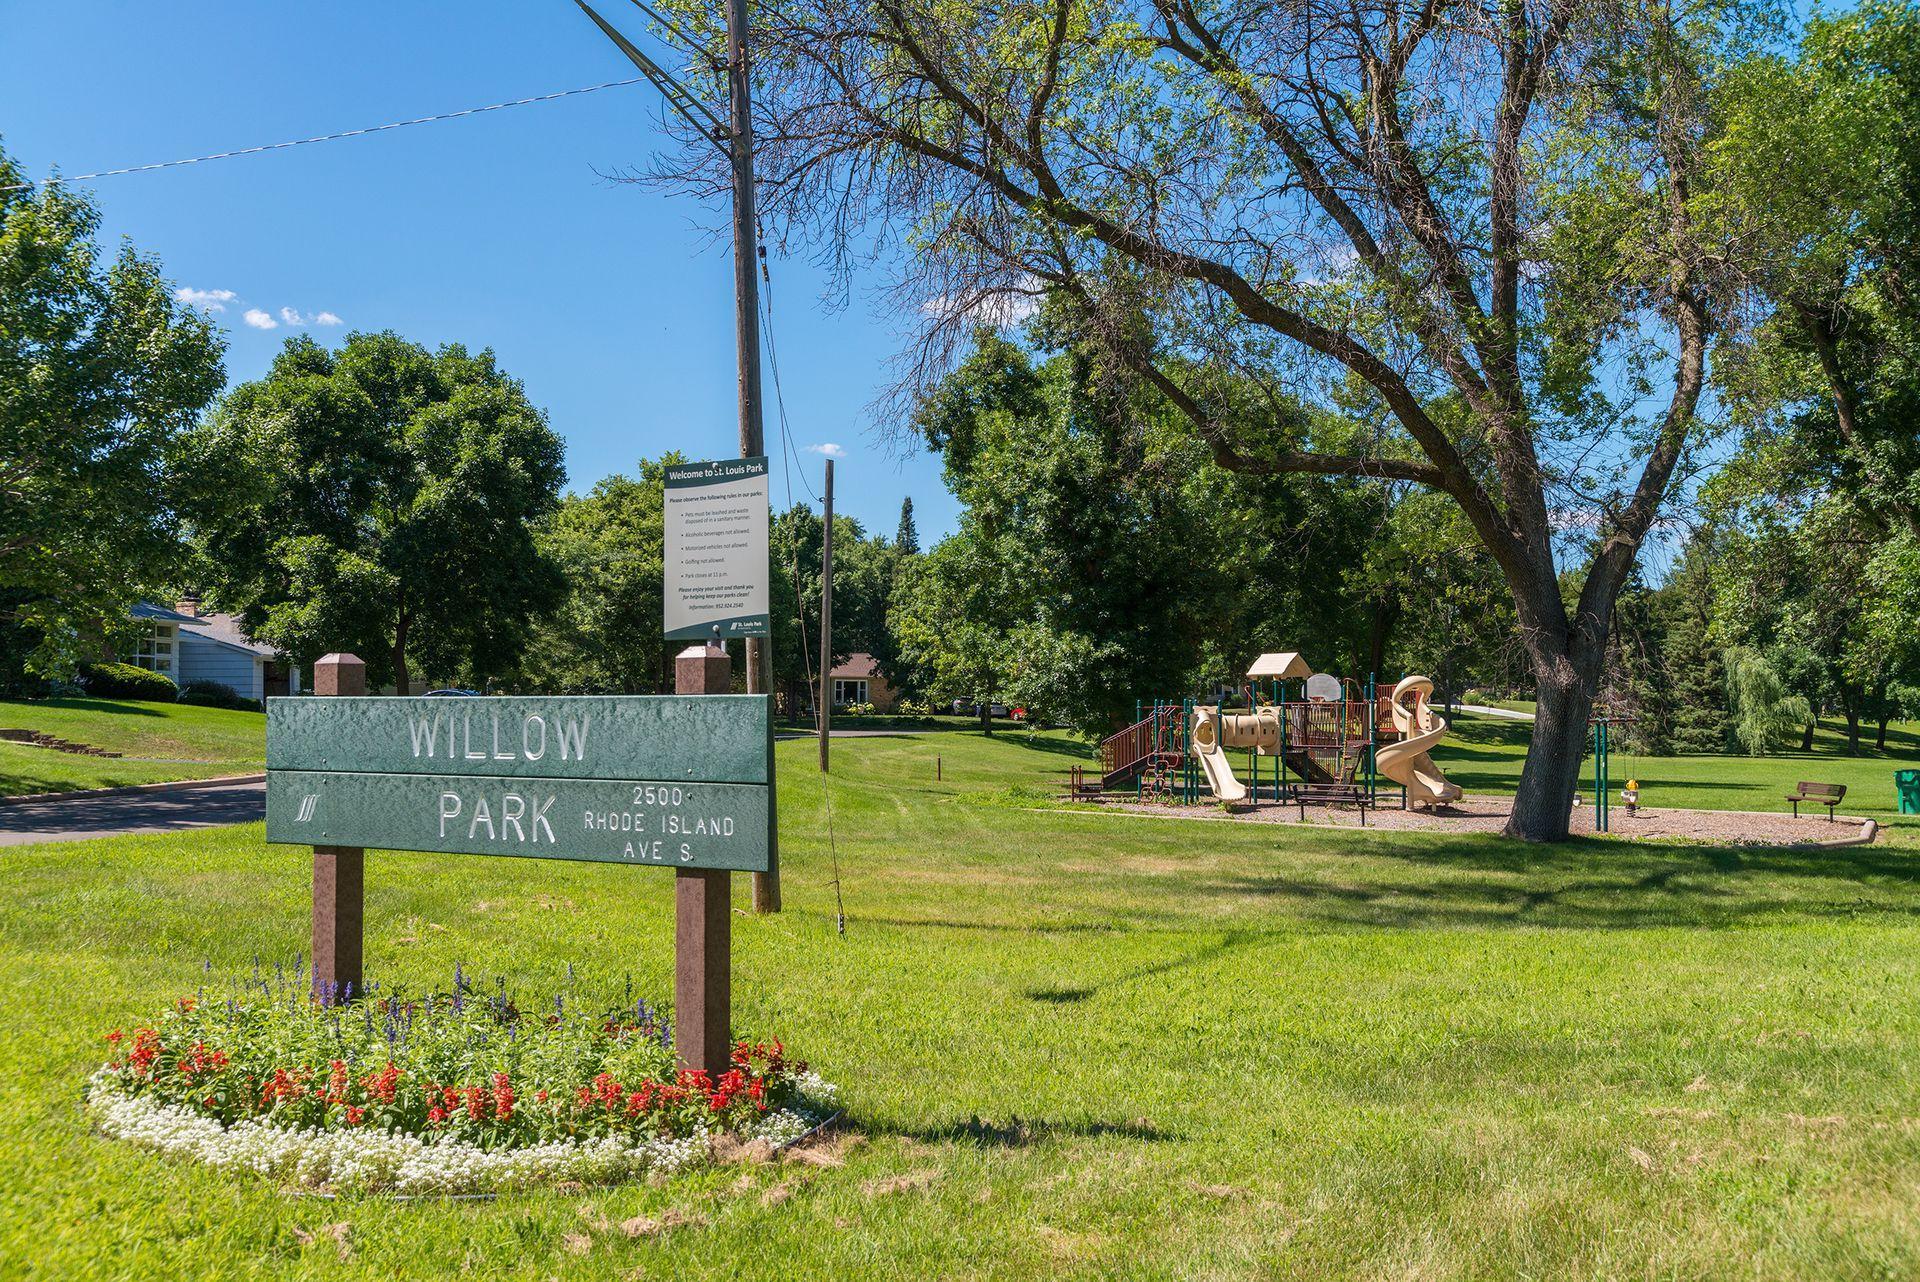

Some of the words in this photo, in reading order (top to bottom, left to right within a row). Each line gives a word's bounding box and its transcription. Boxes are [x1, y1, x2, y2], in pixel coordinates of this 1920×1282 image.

[669, 470, 703, 480] Welcome
[726, 466, 745, 474] Louis
[746, 463, 763, 472] Park
[408, 712, 591, 761] WILLOW
[633, 786, 682, 806] 2500
[439, 790, 556, 844] PARK
[584, 810, 645, 832] RHODE
[661, 815, 734, 837] ISLAND
[623, 841, 663, 860] AVE
